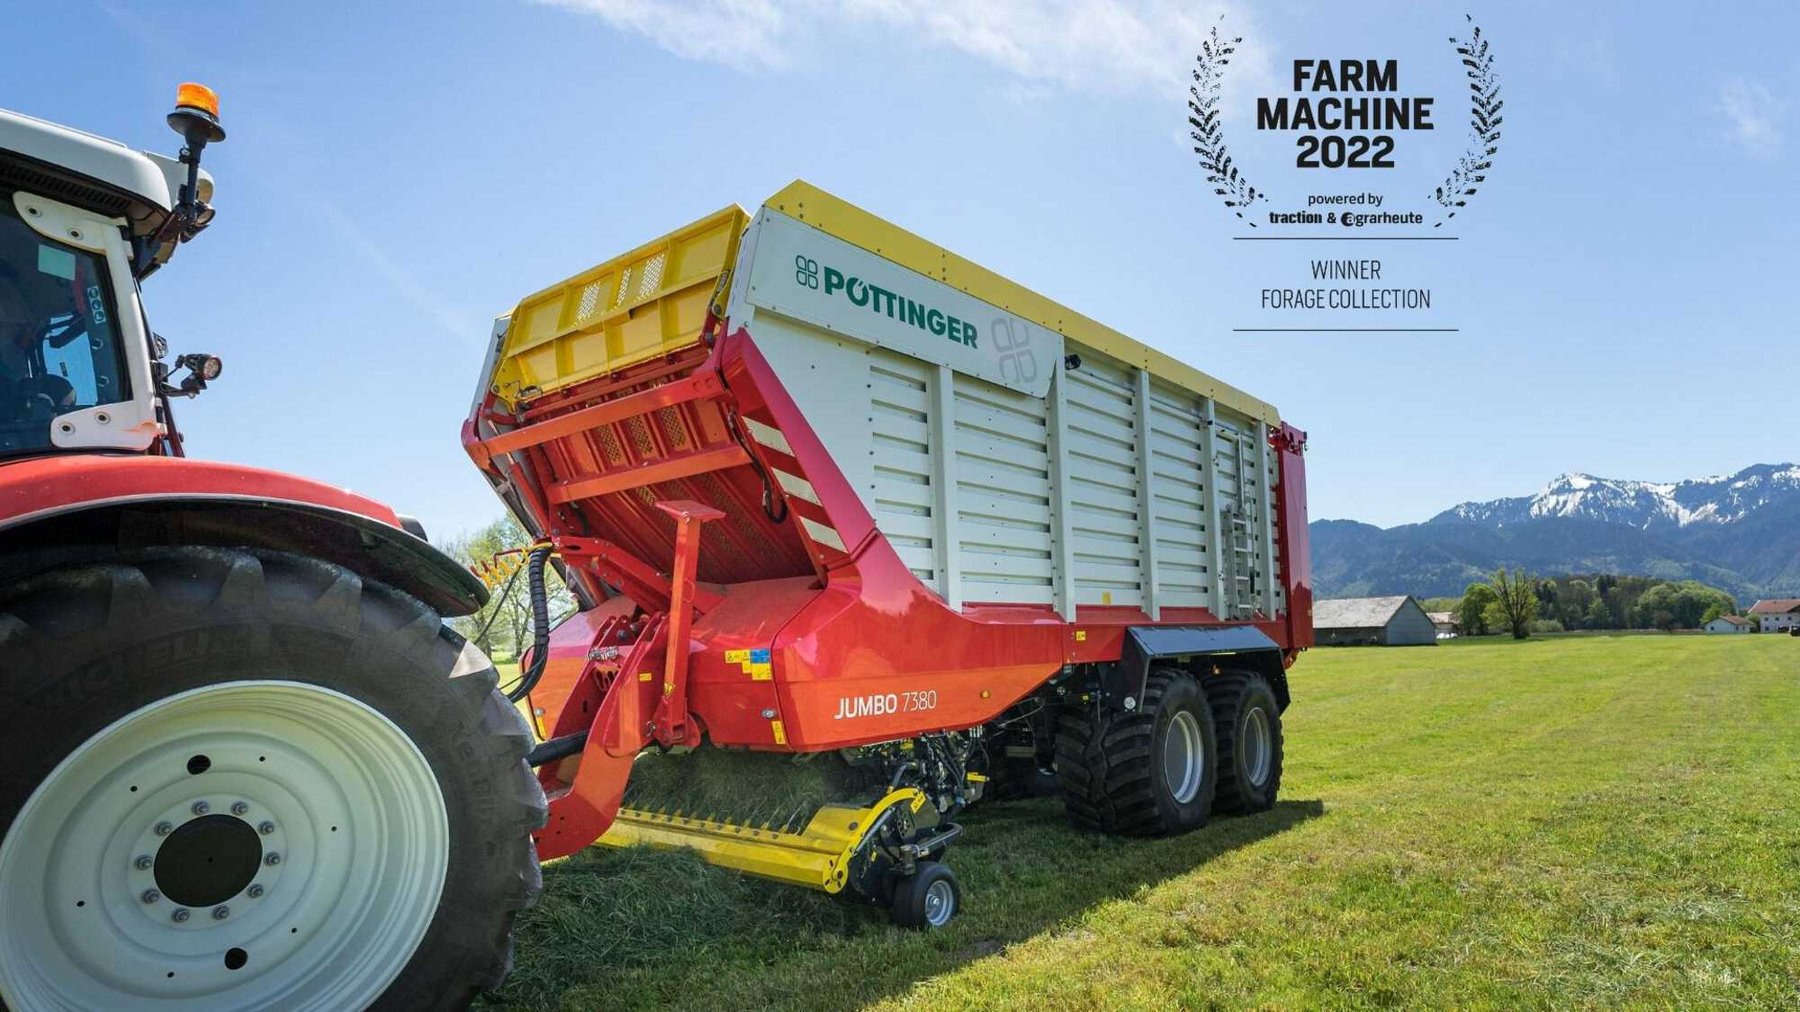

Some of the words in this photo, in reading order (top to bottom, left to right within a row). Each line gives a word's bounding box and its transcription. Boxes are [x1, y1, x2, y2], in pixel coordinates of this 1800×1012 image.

[823, 265, 979, 350] PÖTTINGER
[834, 693, 898, 720] JUMBO
[901, 690, 937, 712] 7380
